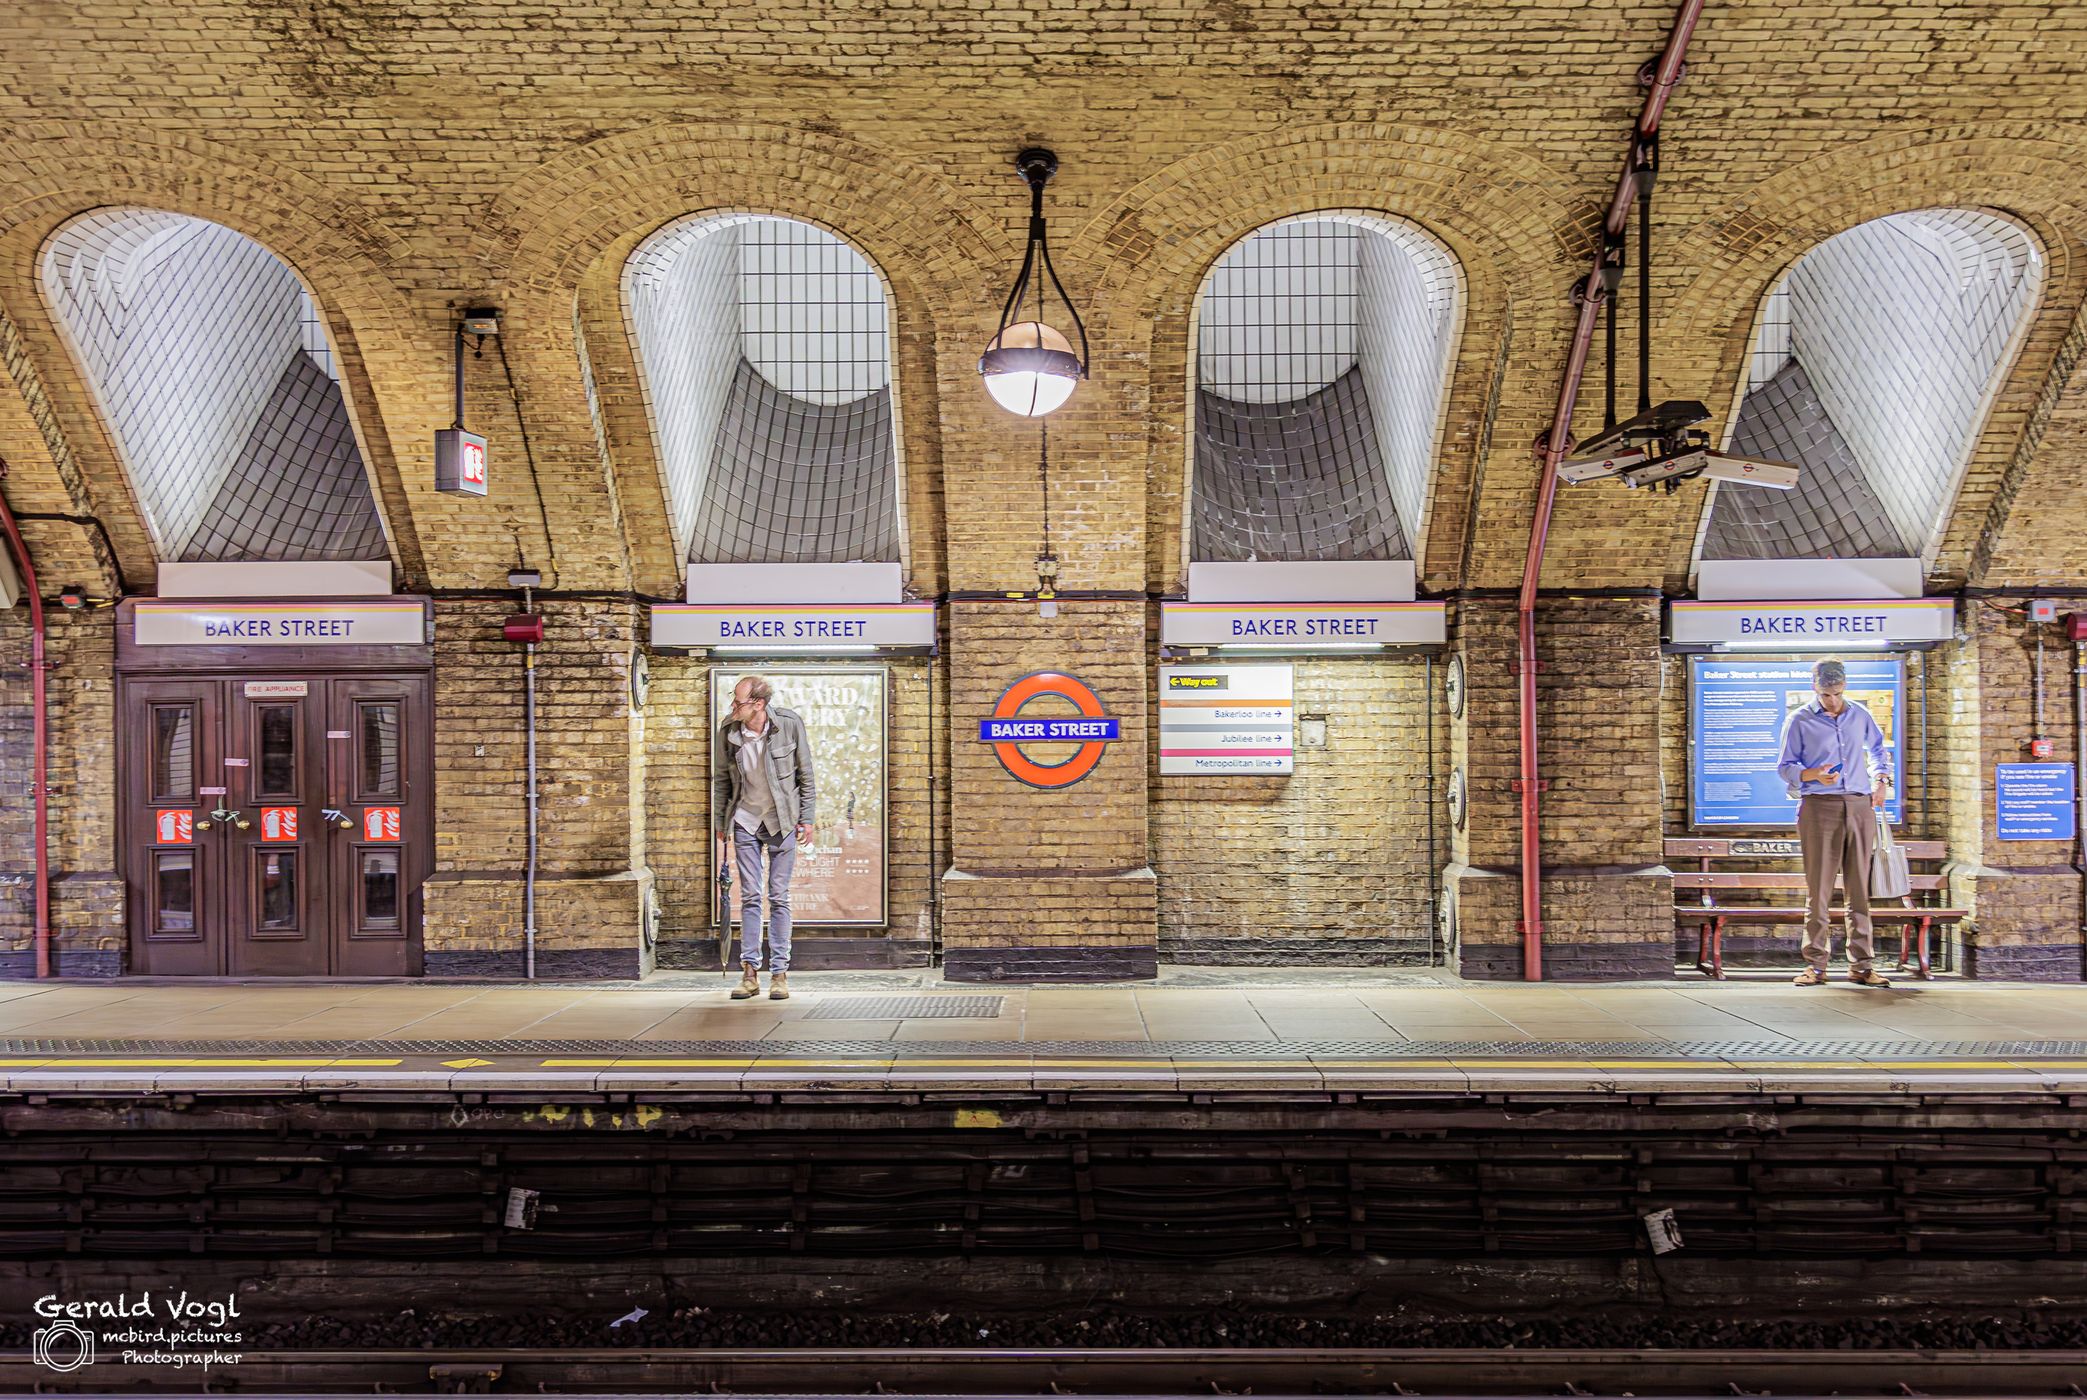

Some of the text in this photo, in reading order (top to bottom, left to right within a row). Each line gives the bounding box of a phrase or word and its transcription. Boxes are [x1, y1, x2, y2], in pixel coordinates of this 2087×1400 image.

[205, 619, 354, 637] BAKER STREET
[720, 620, 867, 637] BAKER STREET
[1232, 618, 1379, 636] BAKER STREET
[1740, 616, 1887, 634] BAKER STREET
[1180, 677, 1218, 688] Way out
[1214, 710, 1272, 718] Bakerloo line
[991, 722, 1109, 737] BAKER STREET
[1221, 735, 1272, 743] Jubilee line
[1195, 759, 1272, 768] Metropolitan line
[1752, 843, 1793, 853] BAKER
